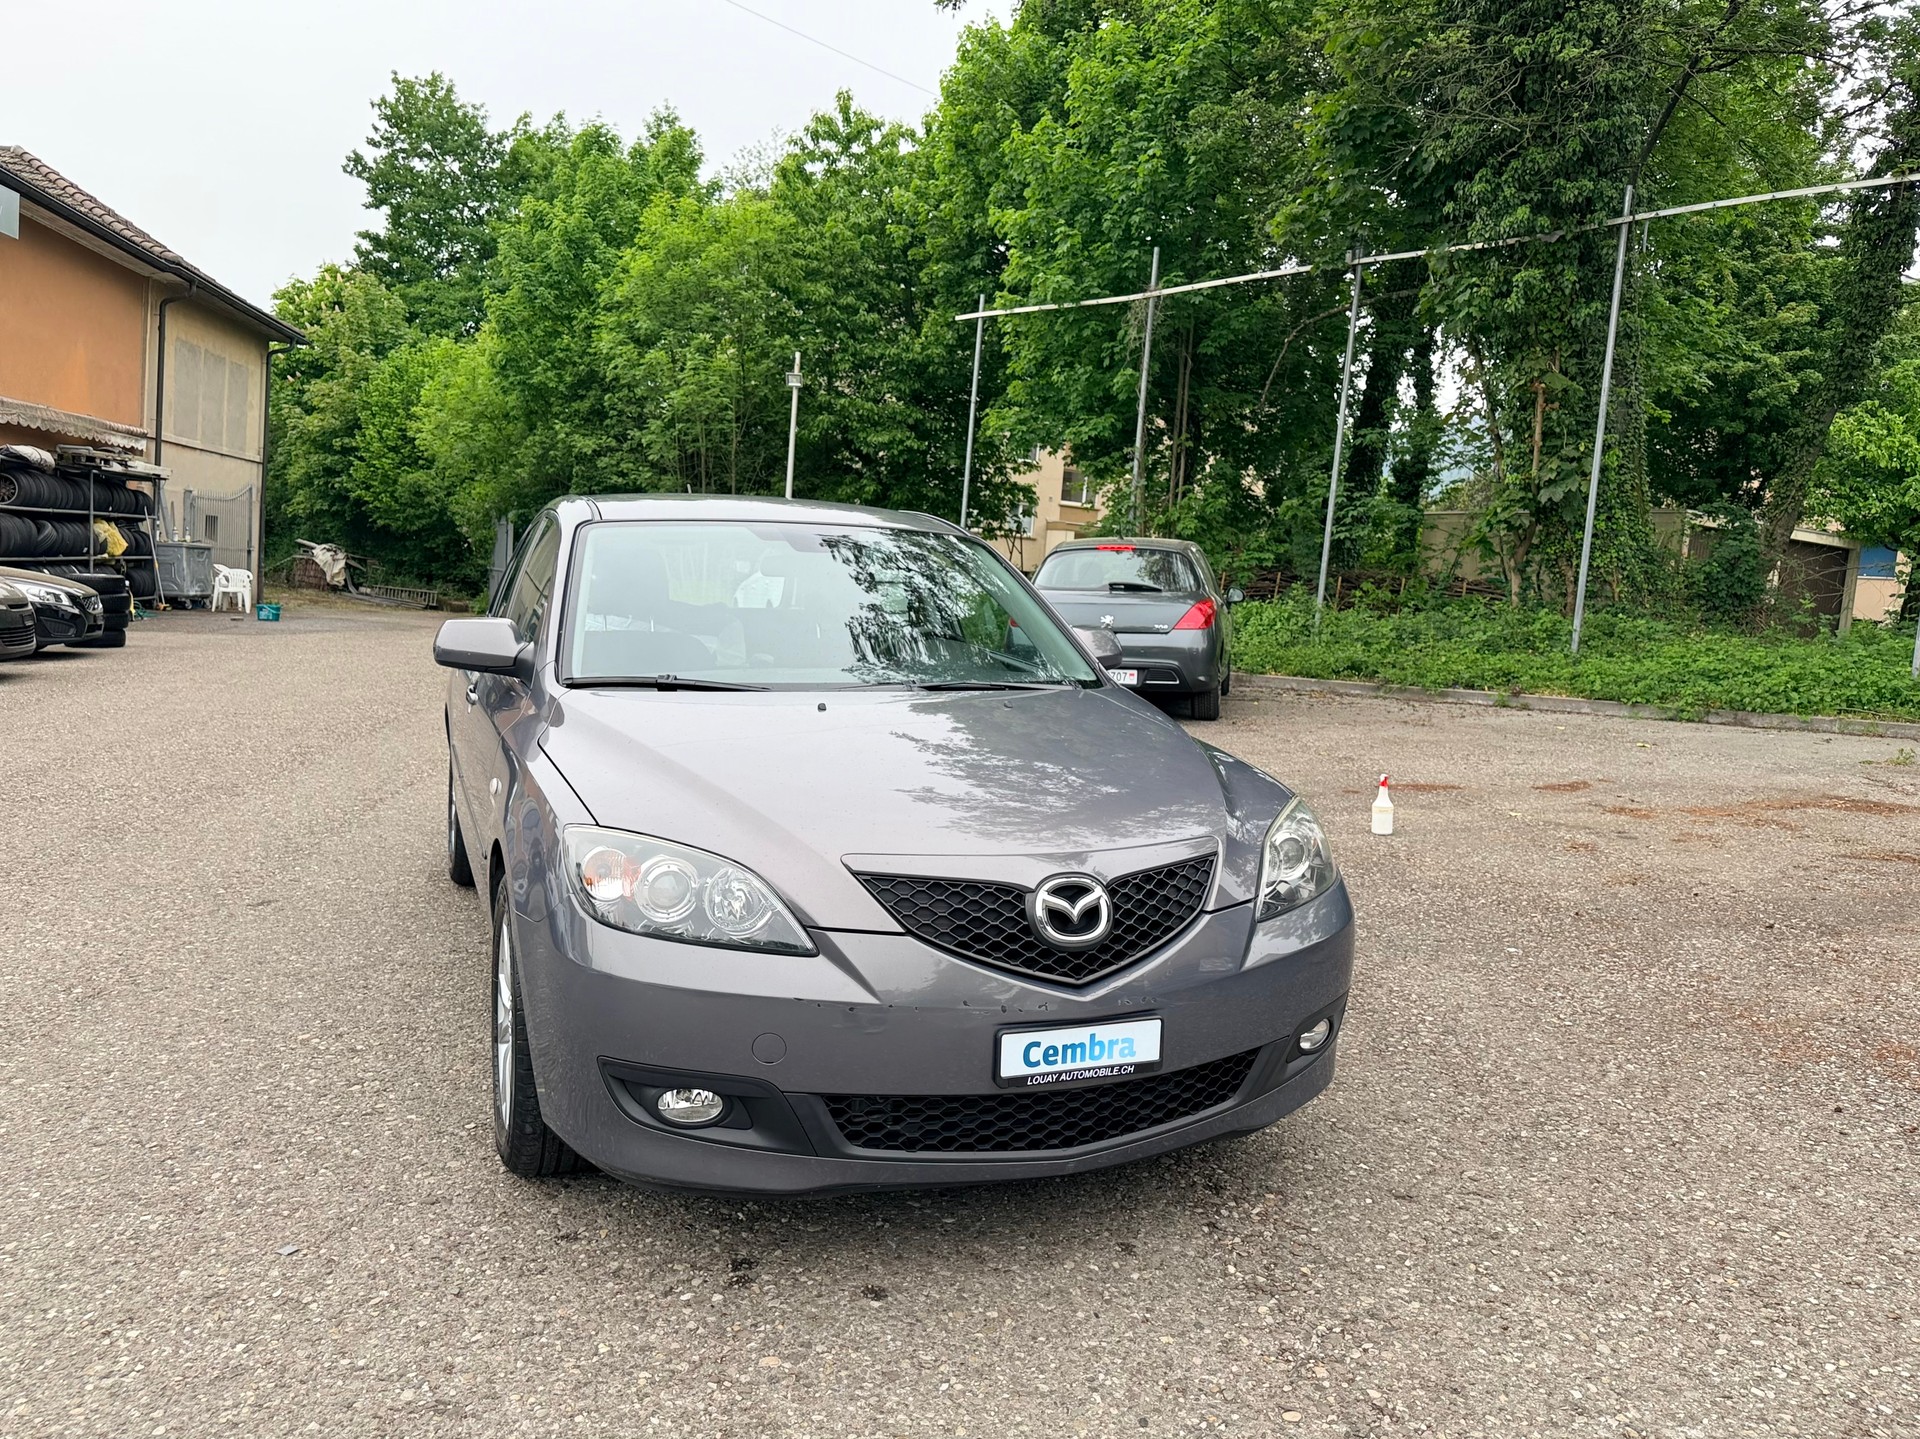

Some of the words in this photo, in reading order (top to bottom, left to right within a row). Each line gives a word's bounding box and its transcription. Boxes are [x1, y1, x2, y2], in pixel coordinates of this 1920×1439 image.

[1107, 671, 1128, 682] 707
[1022, 1033, 1136, 1068] Cembra
[1027, 1073, 1058, 1085] LOUAY
[1059, 1065, 1135, 1082] AUTOMOBILE.CH
